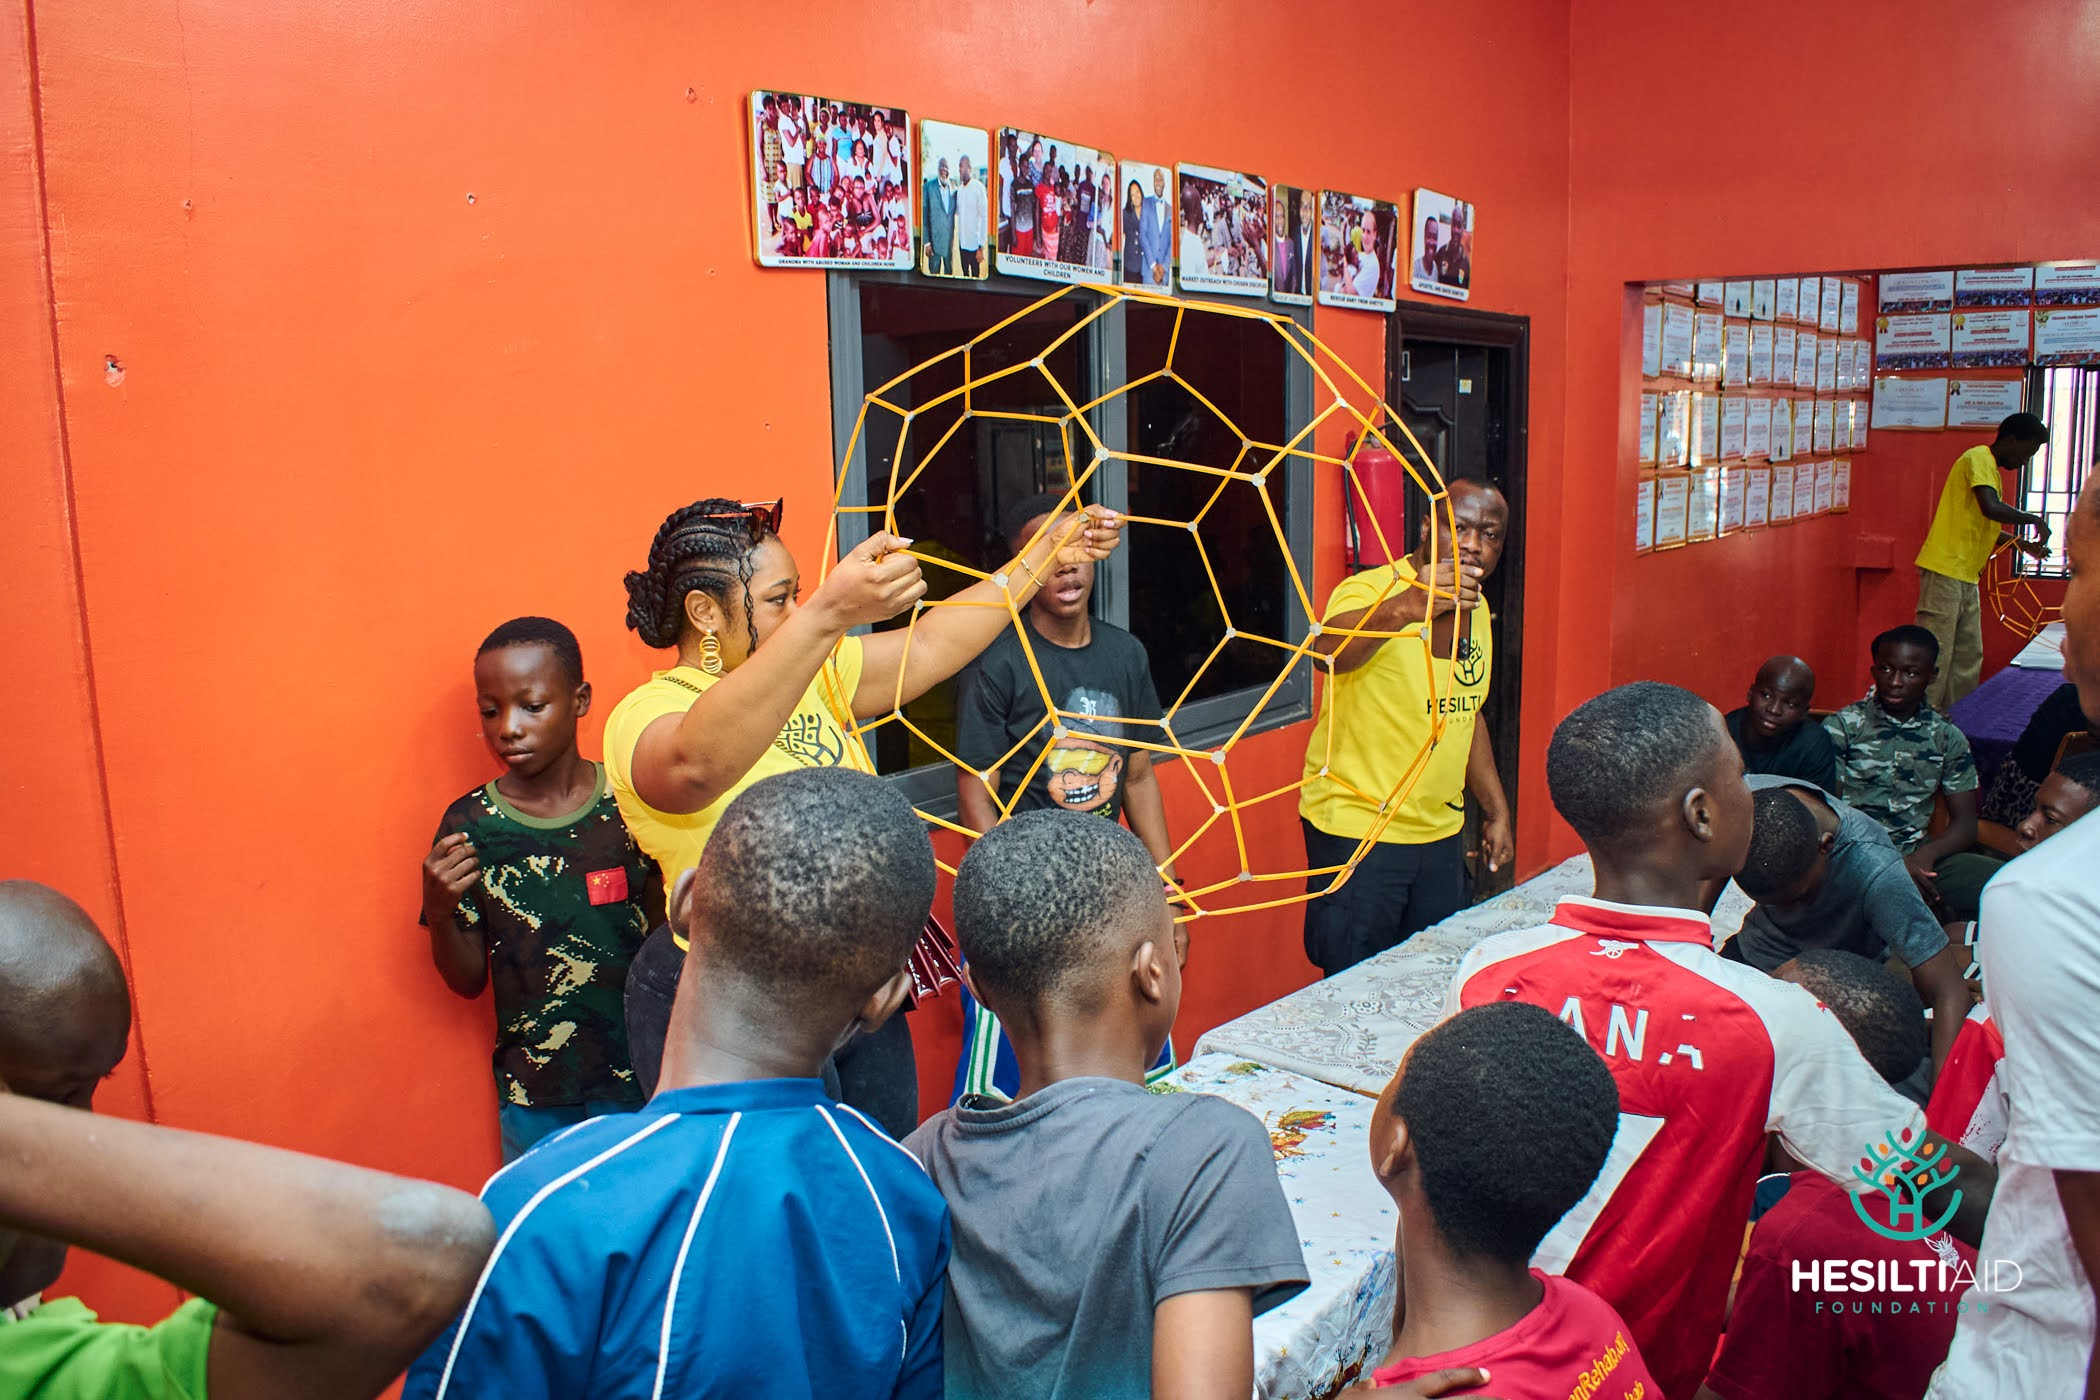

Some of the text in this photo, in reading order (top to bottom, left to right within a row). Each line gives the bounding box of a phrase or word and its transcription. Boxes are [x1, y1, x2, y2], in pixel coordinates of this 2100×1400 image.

[1005, 255, 1105, 277] VOLUNTEERS WITH OUR WOMEN AND
[1043, 268, 1071, 279] CHILDREN
[1233, 279, 1249, 287] CHOSEN
